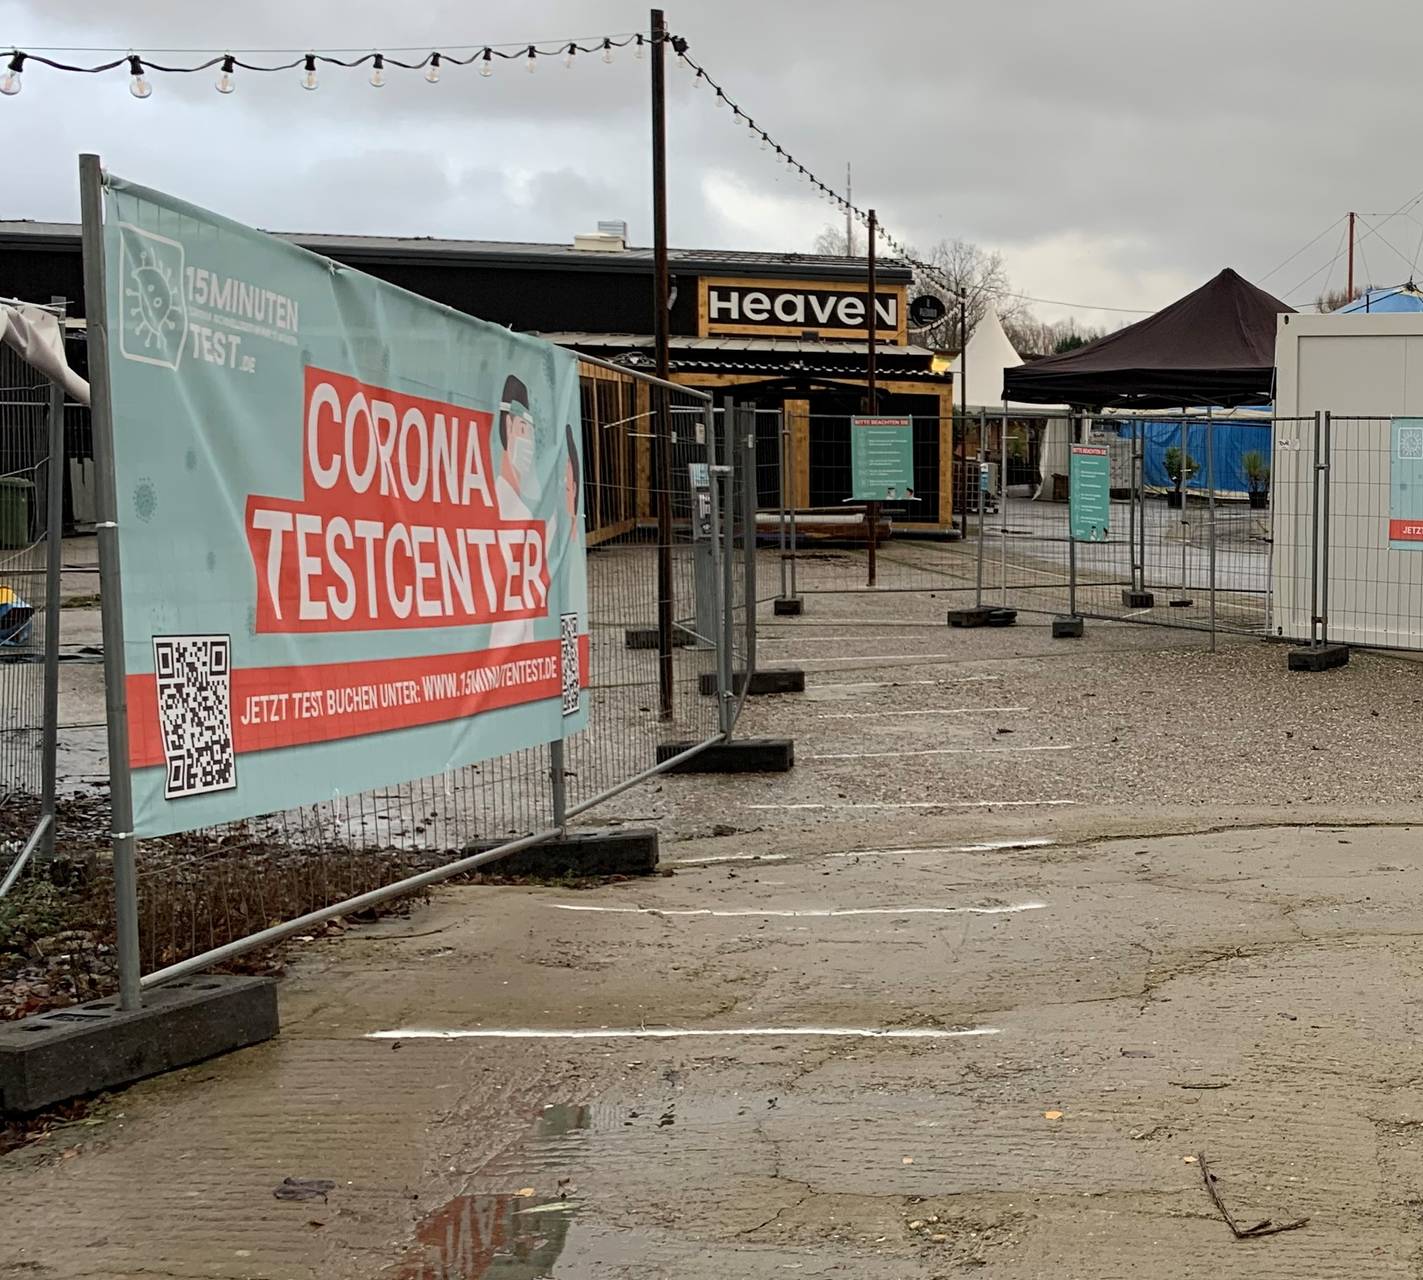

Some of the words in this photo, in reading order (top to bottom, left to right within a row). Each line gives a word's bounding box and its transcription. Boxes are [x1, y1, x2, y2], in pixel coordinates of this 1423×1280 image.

[186, 266, 298, 333] 15MINUTEN
[308, 383, 494, 507] CORONA
[252, 509, 546, 620] TESTCENTER
[240, 693, 289, 725] JETZT
[292, 690, 325, 719] TEST
[327, 685, 378, 715] BUCHEN
[380, 680, 421, 707] UNTER:
